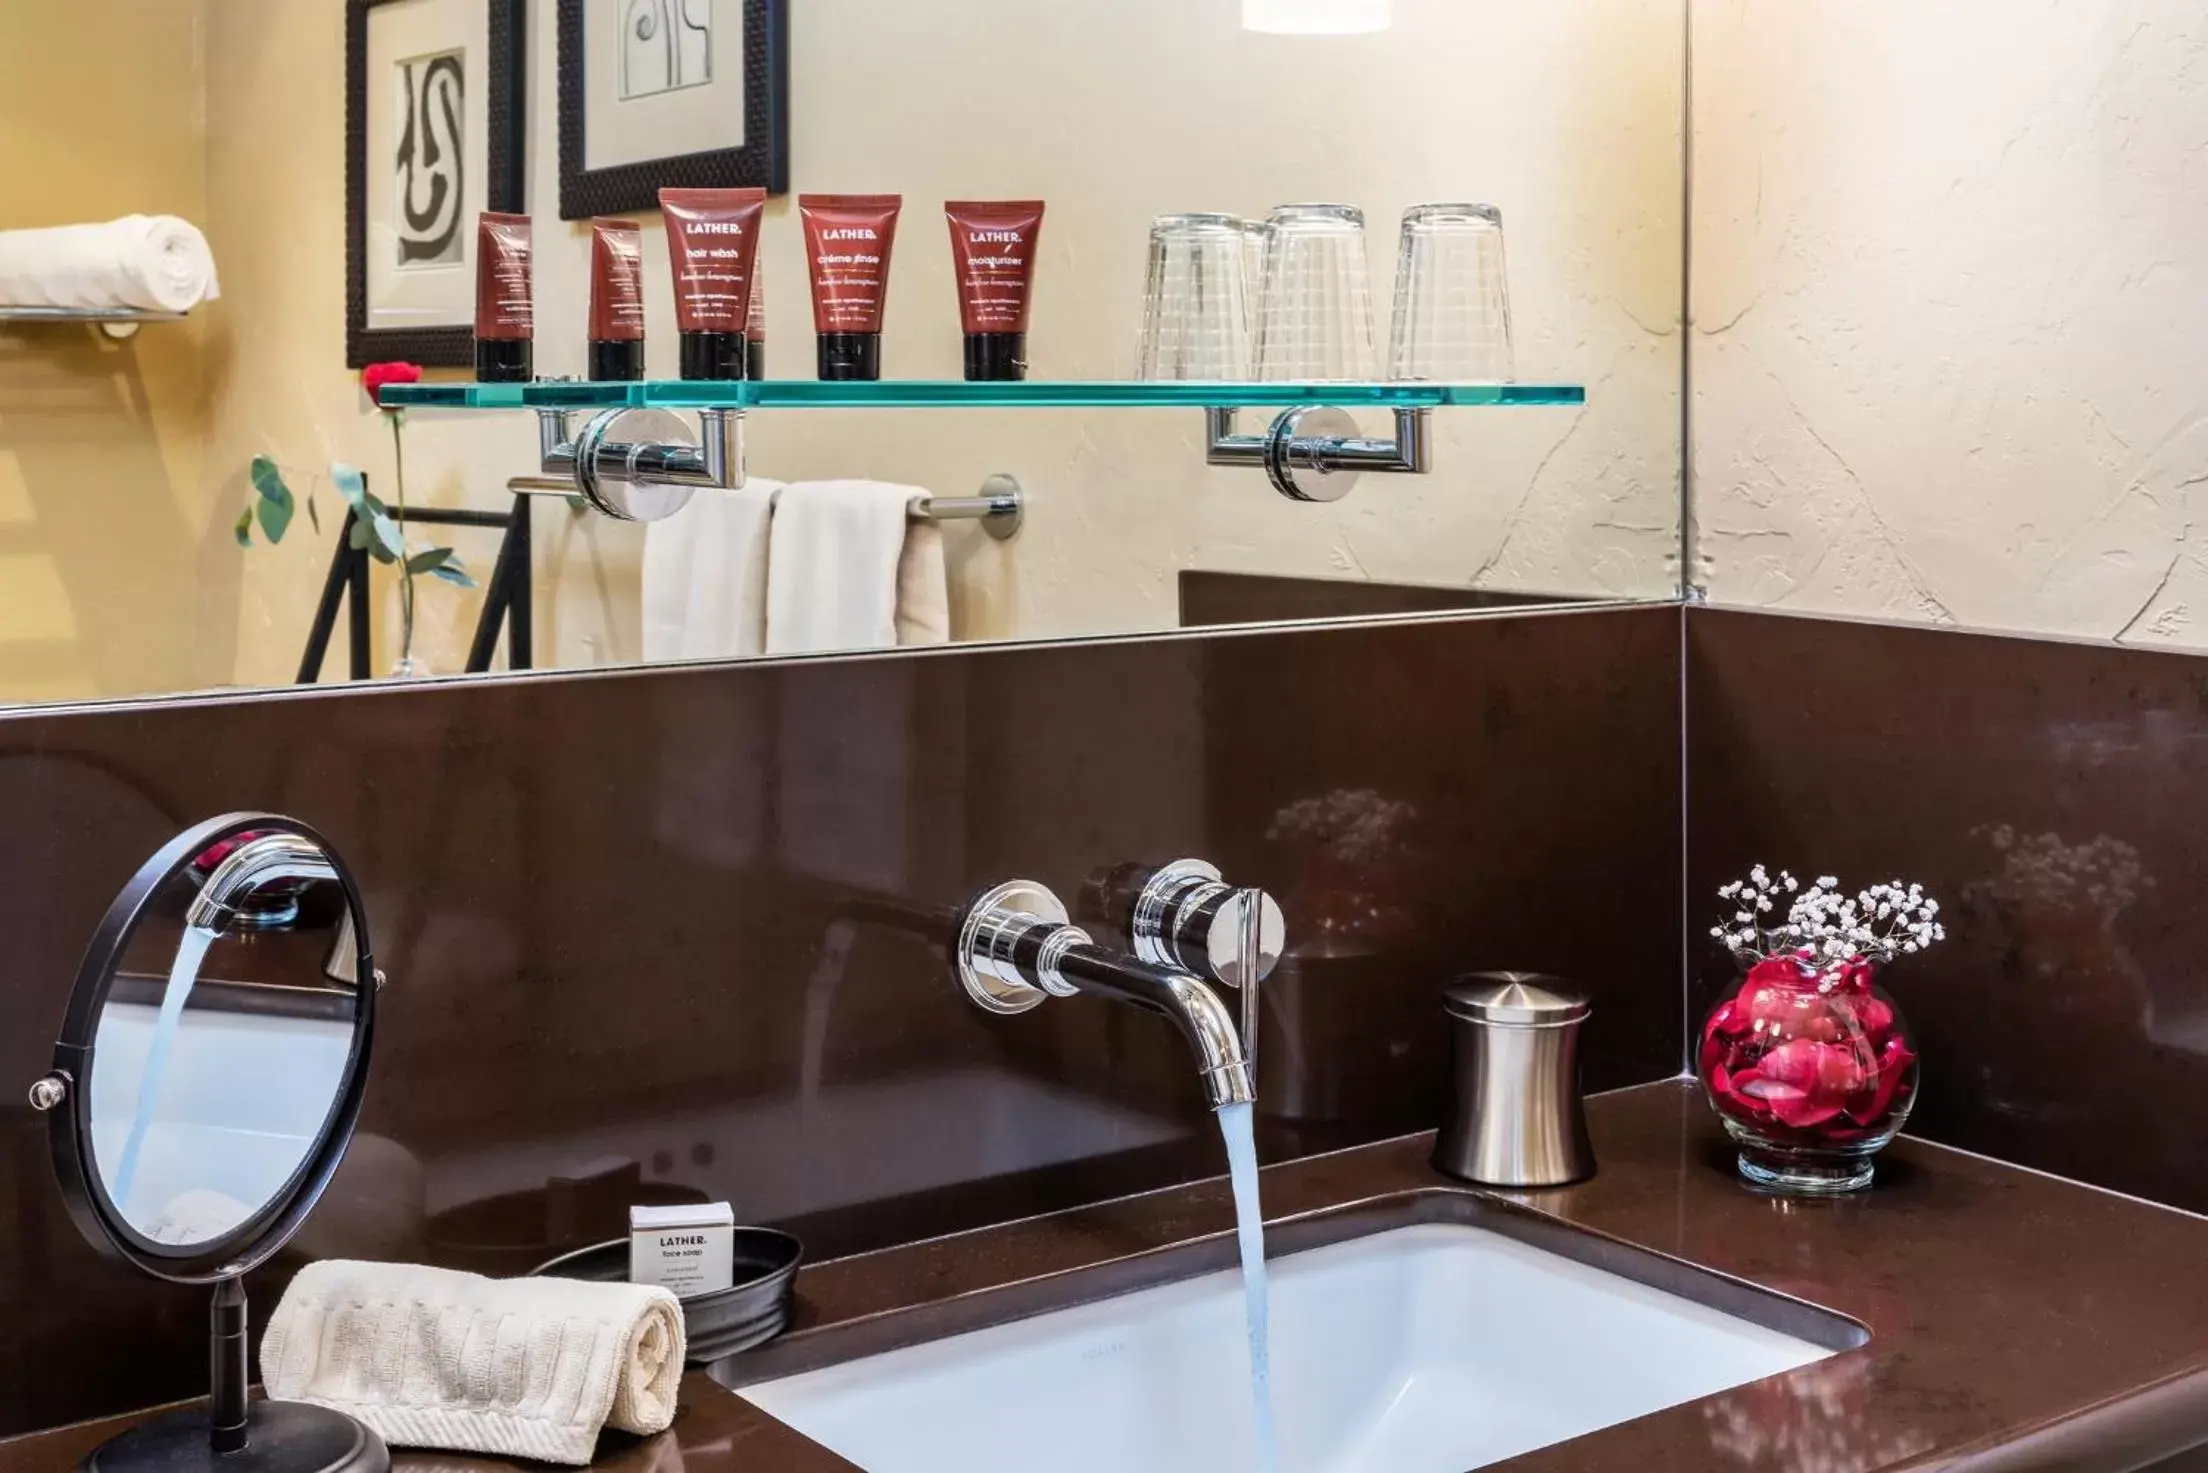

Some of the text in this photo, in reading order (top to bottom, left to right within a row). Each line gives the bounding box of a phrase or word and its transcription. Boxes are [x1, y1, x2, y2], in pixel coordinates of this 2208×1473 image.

[686, 223, 743, 234] LATHER.
[822, 228, 877, 240] LATHER.
[970, 231, 1022, 243] LATHER.
[685, 248, 739, 259] hair wash
[660, 1235, 708, 1247] LATHER.
